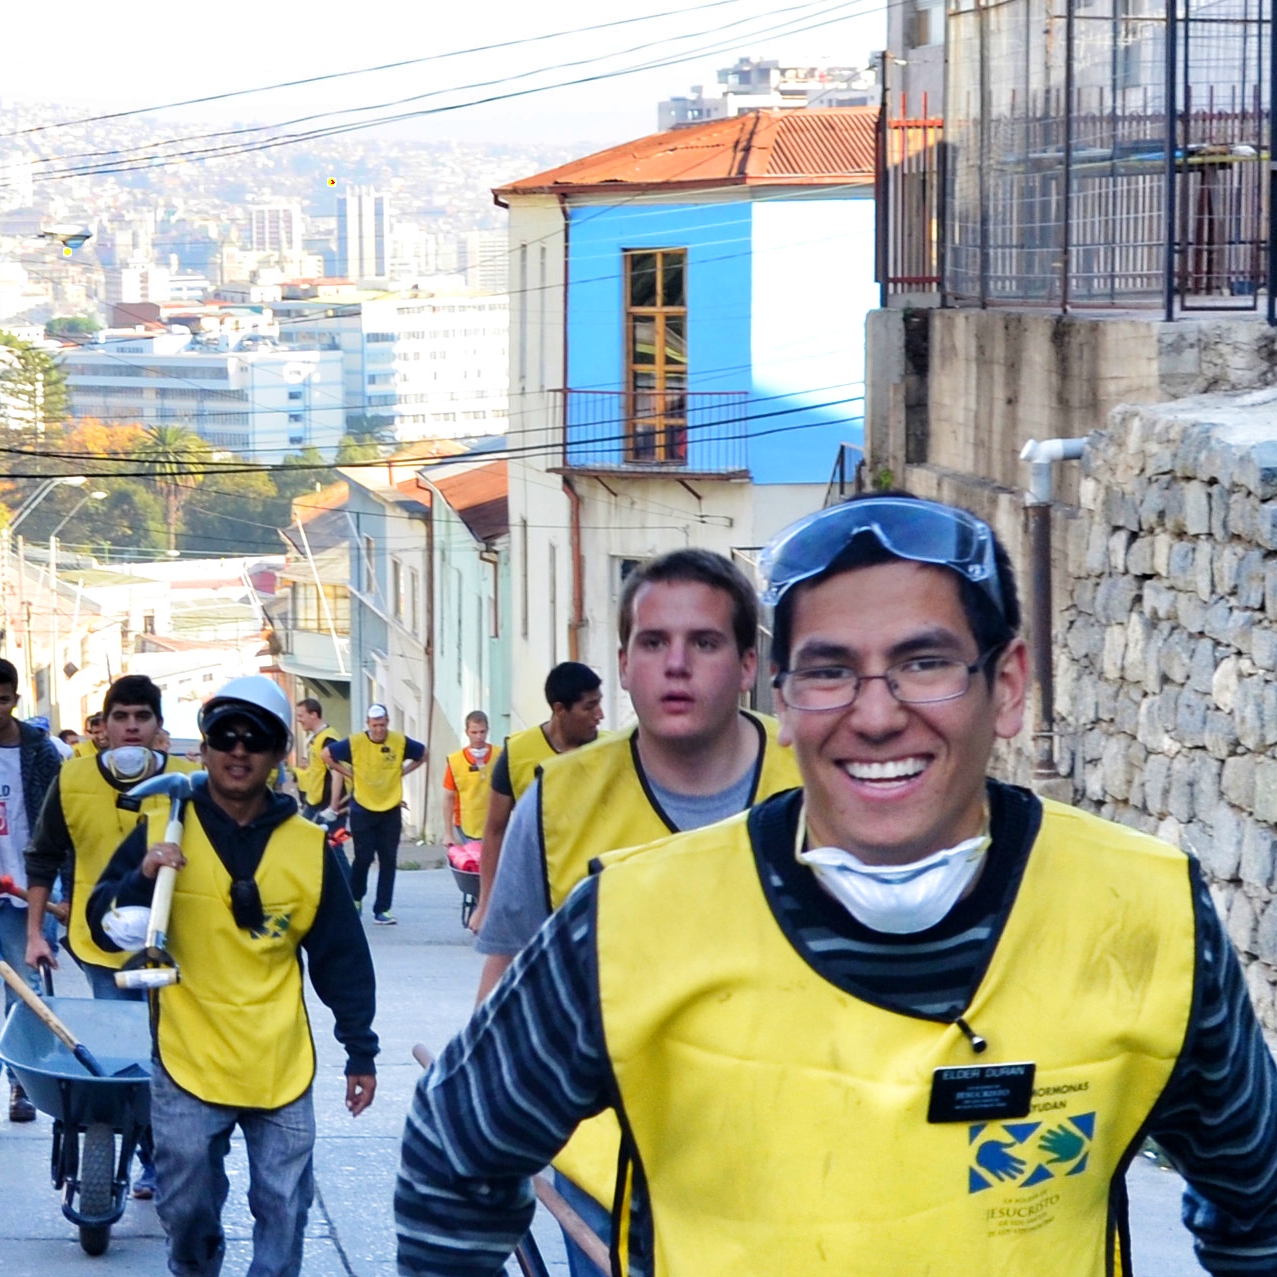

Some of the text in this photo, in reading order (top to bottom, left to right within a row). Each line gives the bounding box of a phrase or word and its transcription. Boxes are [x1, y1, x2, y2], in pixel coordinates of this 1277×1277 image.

[942, 1066, 1025, 1081] ELDER DURAN
[1031, 1100, 1067, 1113] YUDAN
[986, 1193, 1060, 1222] JESUCRISTO
